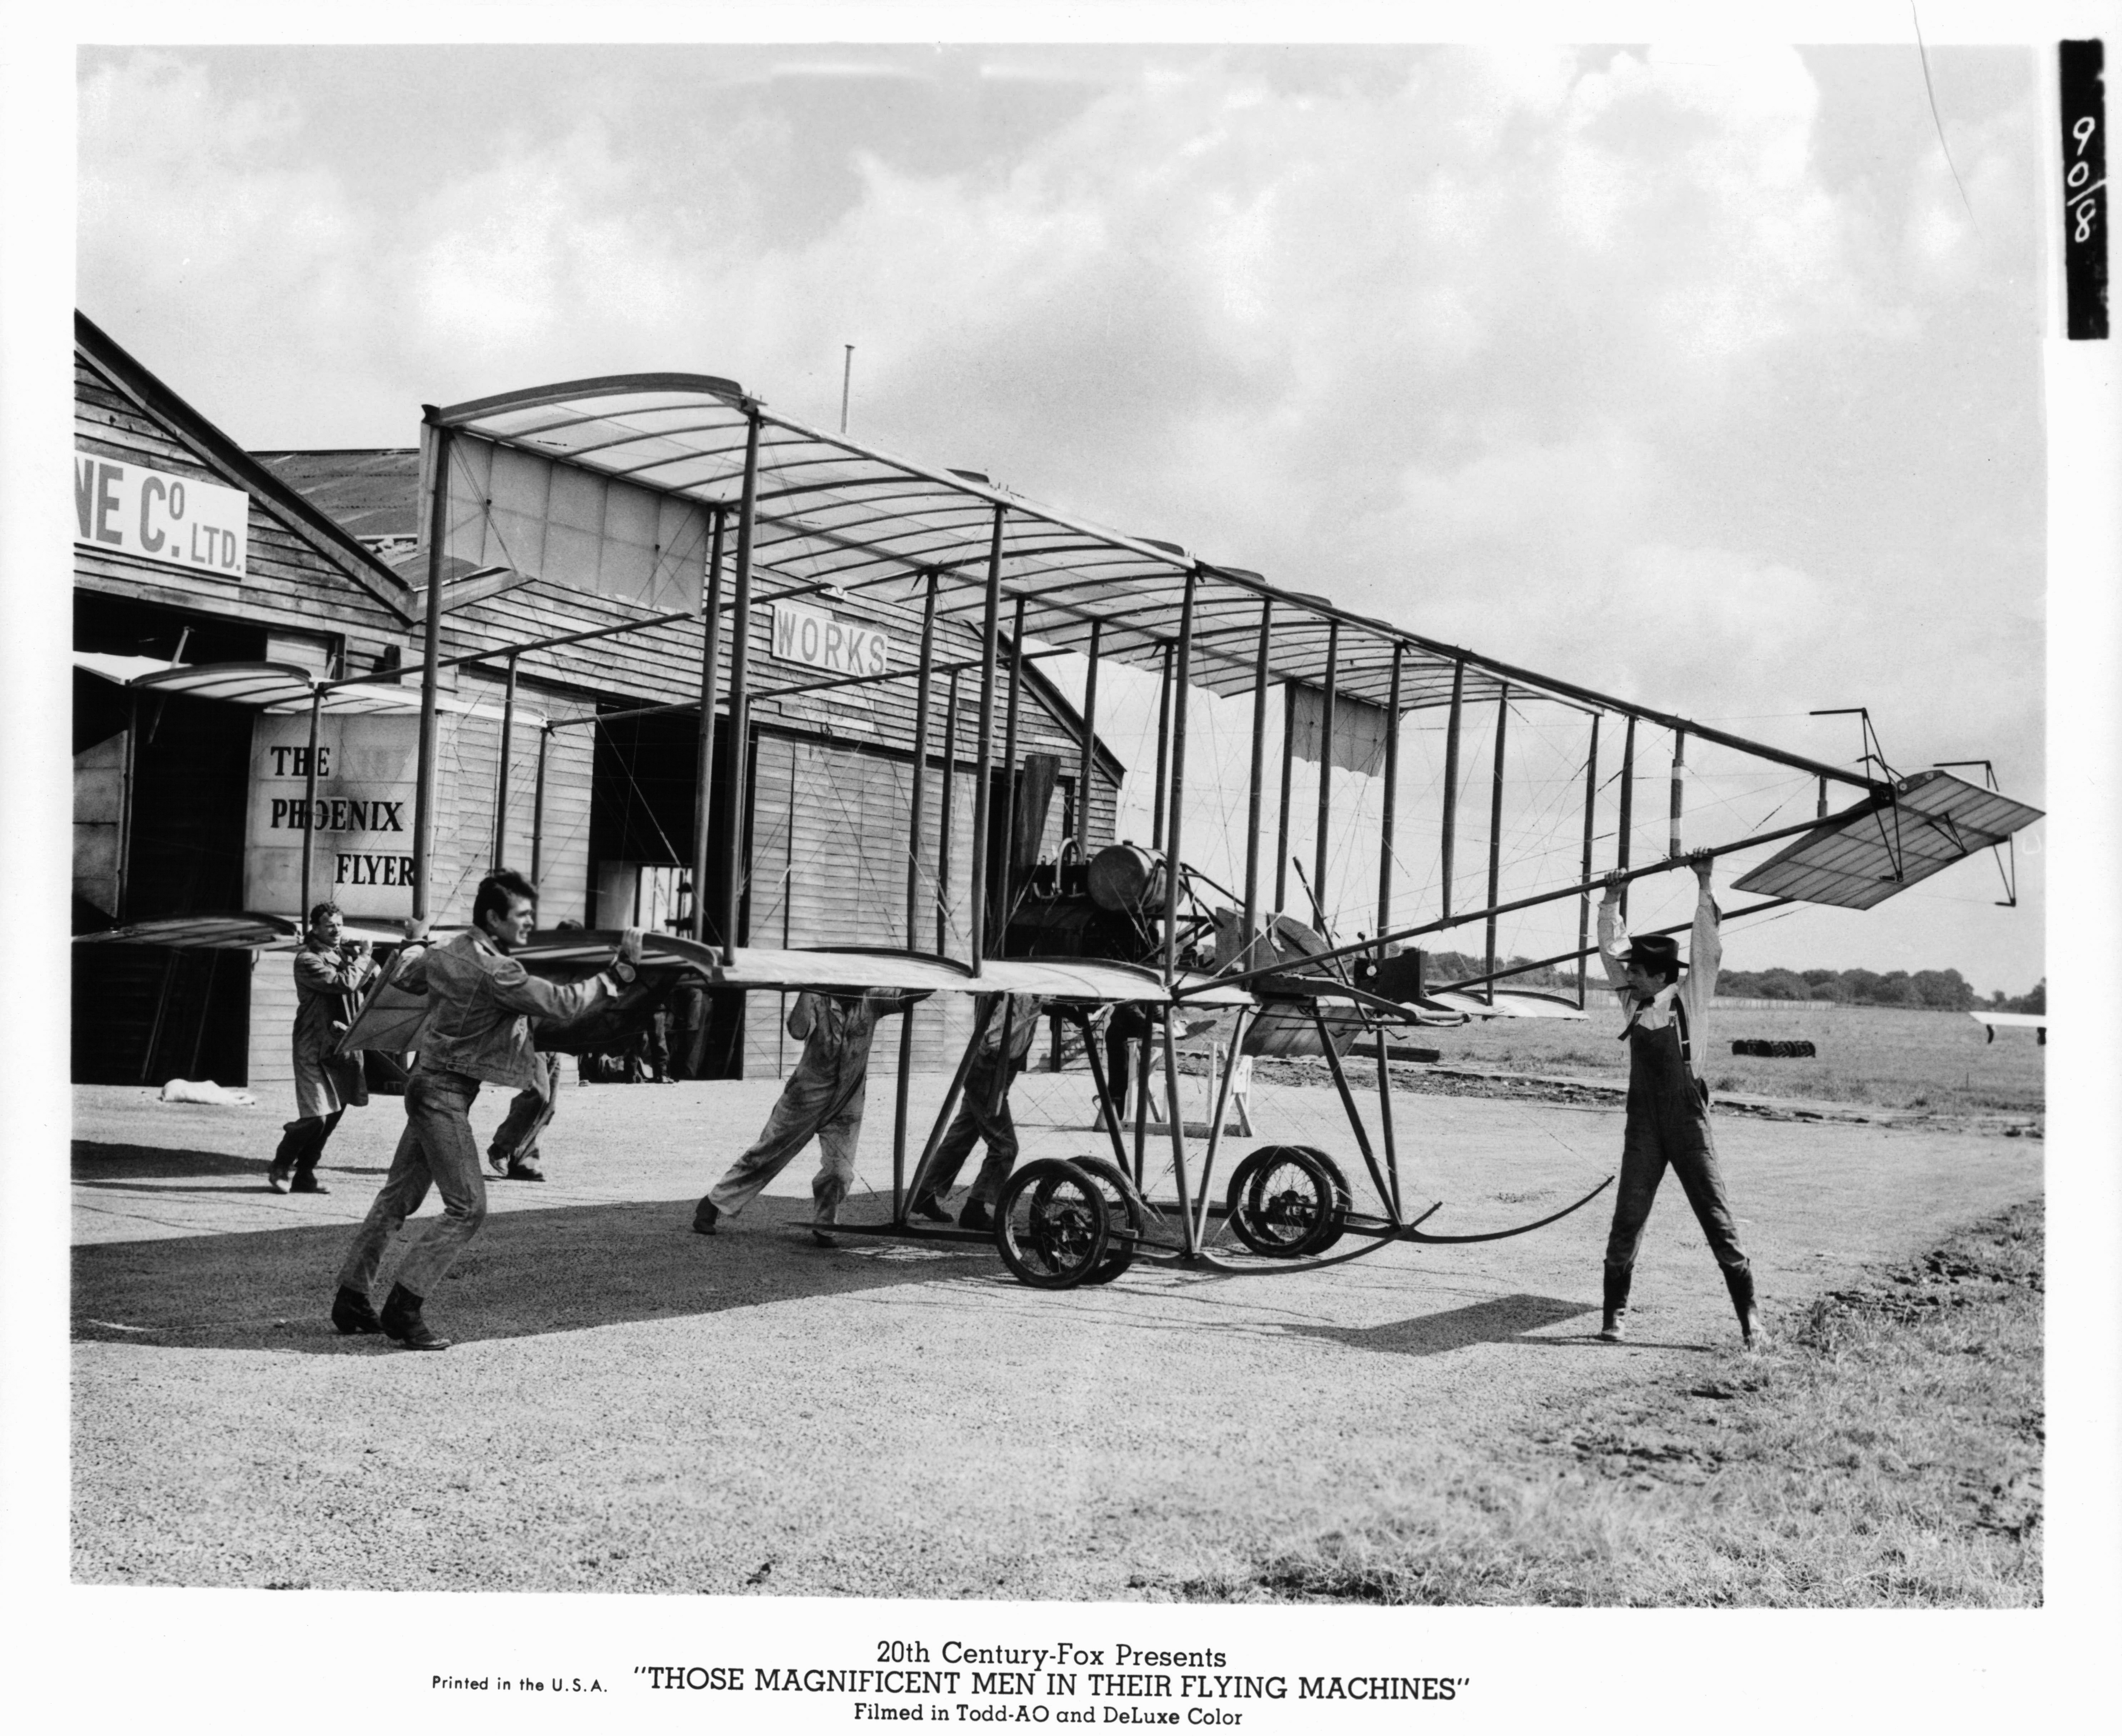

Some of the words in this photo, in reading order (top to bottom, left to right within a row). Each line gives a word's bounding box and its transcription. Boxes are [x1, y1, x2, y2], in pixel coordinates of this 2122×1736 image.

[191, 522, 241, 572] LTD.
[777, 608, 885, 675] WORKS
[270, 746, 330, 776] THE
[270, 799, 403, 832] PHOENIX
[335, 854, 414, 886] FLYER
